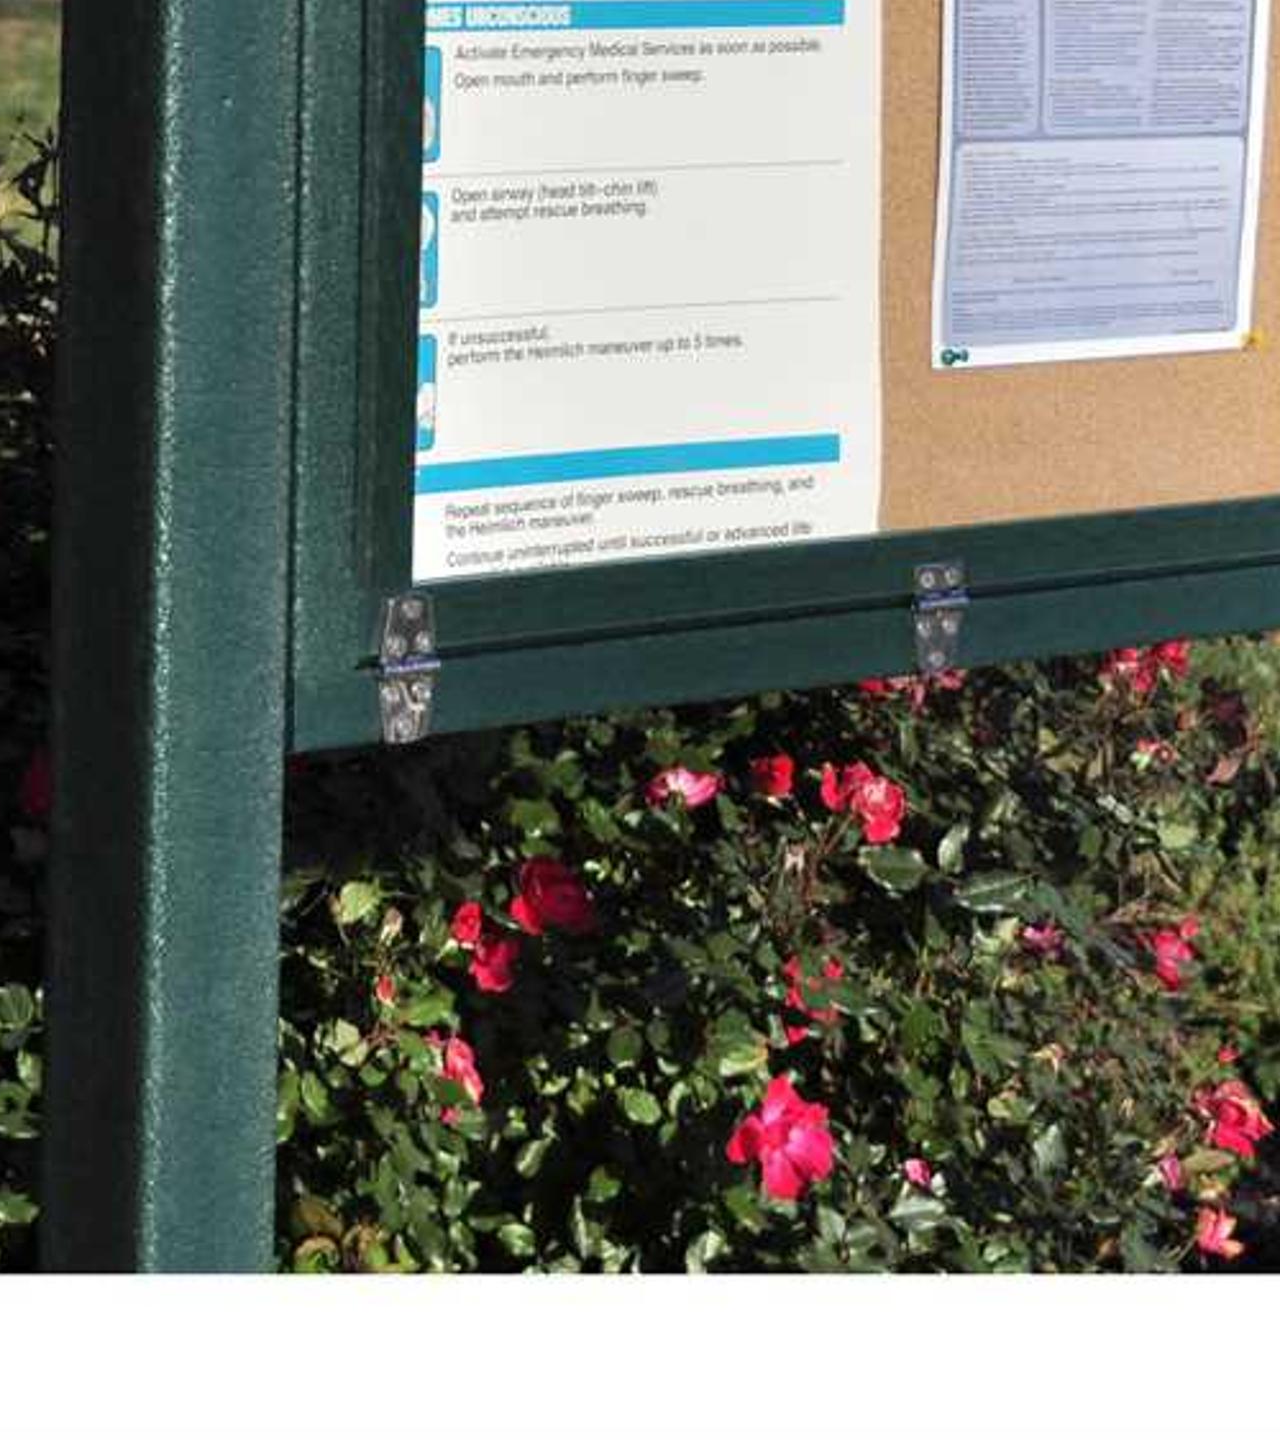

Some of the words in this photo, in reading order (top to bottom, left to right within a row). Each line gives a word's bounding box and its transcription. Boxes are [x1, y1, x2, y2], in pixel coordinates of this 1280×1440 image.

[454, 44, 508, 60] Activate
[512, 43, 586, 62] Emergency
[589, 40, 638, 57] Medical
[642, 40, 696, 56] Services
[717, 40, 748, 55] soon
[454, 72, 490, 90] Open
[493, 70, 535, 88] mouth
[538, 71, 564, 86] and
[566, 71, 619, 88] perform
[622, 68, 658, 87] finger
[451, 186, 487, 206] Open
[491, 186, 535, 206] airway
[537, 183, 576, 203] (head
[451, 207, 477, 223] and
[480, 205, 530, 222] attempt
[532, 204, 579, 219] rescue
[448, 348, 501, 368] perform
[503, 347, 525, 363] the
[528, 341, 585, 359] Heimlich
[587, 339, 654, 356] maneuver
[656, 338, 675, 354] up
[445, 502, 491, 520] Repeat
[493, 496, 558, 516] sequence
[559, 493, 575, 510] of
[576, 490, 615, 510] finger
[668, 483, 714, 502] rescue
[788, 474, 815, 491] and
[445, 523, 467, 539] the
[469, 517, 526, 535] Heimlich
[446, 550, 505, 569] Continue
[507, 536, 596, 561] uninterrupted
[599, 532, 628, 550] until
[630, 527, 705, 549] successful
[724, 521, 790, 542] advanced
